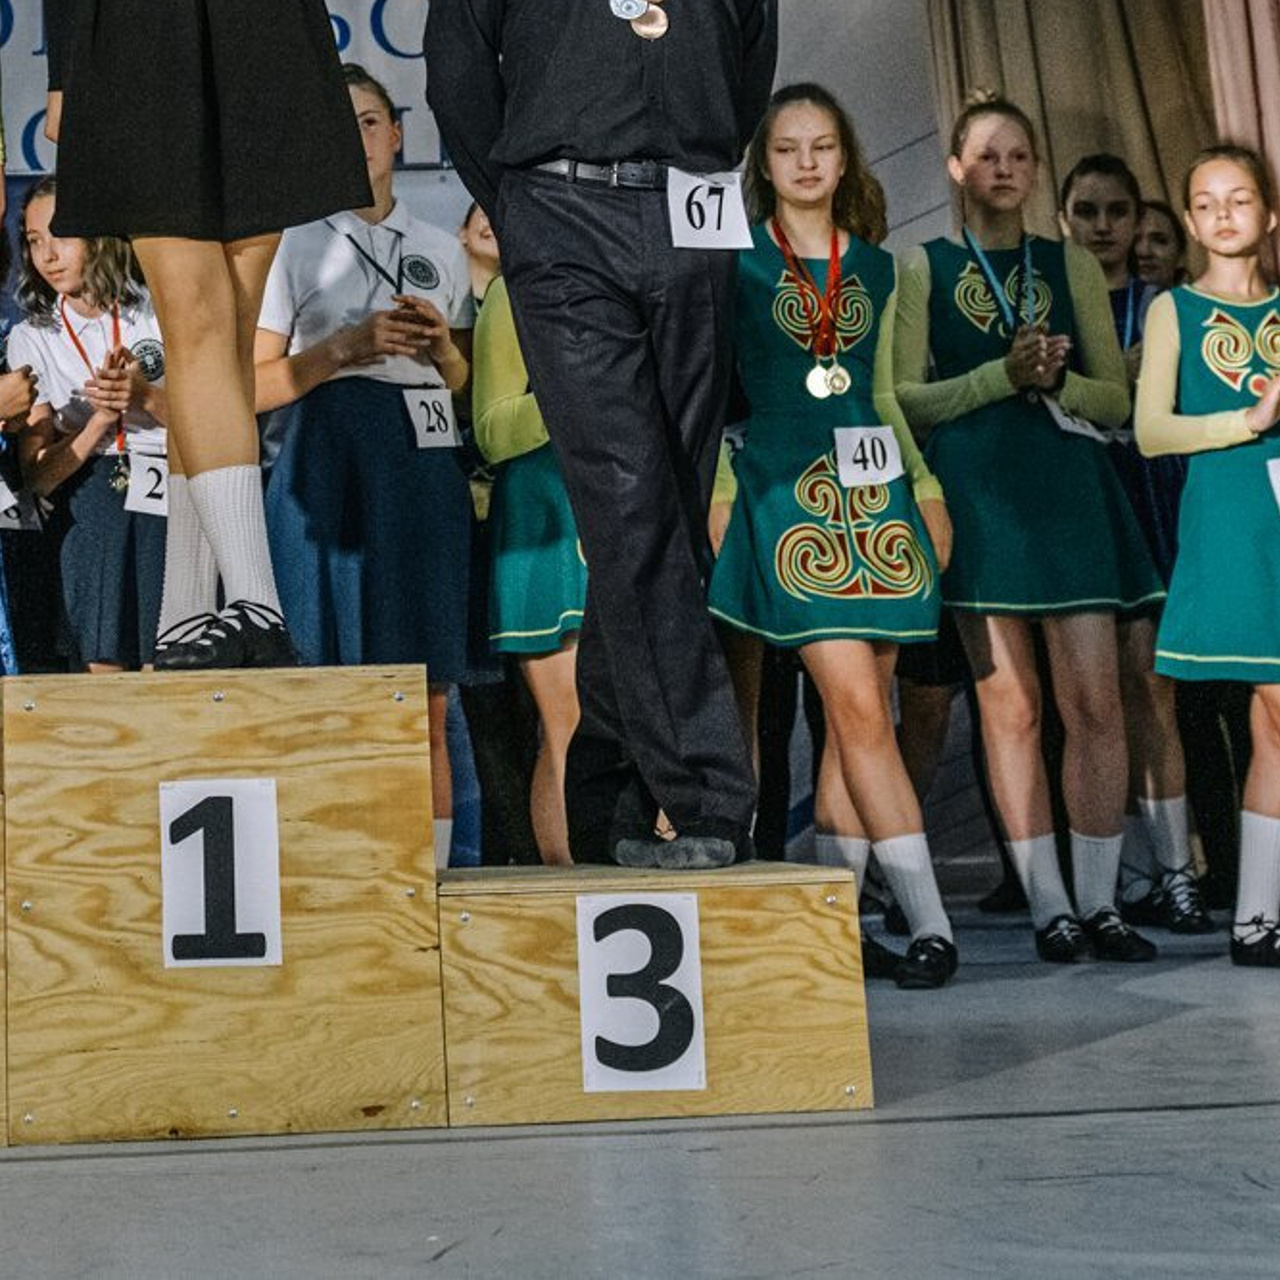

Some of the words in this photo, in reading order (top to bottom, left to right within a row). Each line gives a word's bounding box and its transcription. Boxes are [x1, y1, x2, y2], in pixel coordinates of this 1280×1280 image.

[685, 184, 725, 231] 67
[418, 400, 449, 433] 28
[852, 436, 887, 471] 40
[169, 796, 266, 960] 1
[592, 903, 695, 1072] 3
